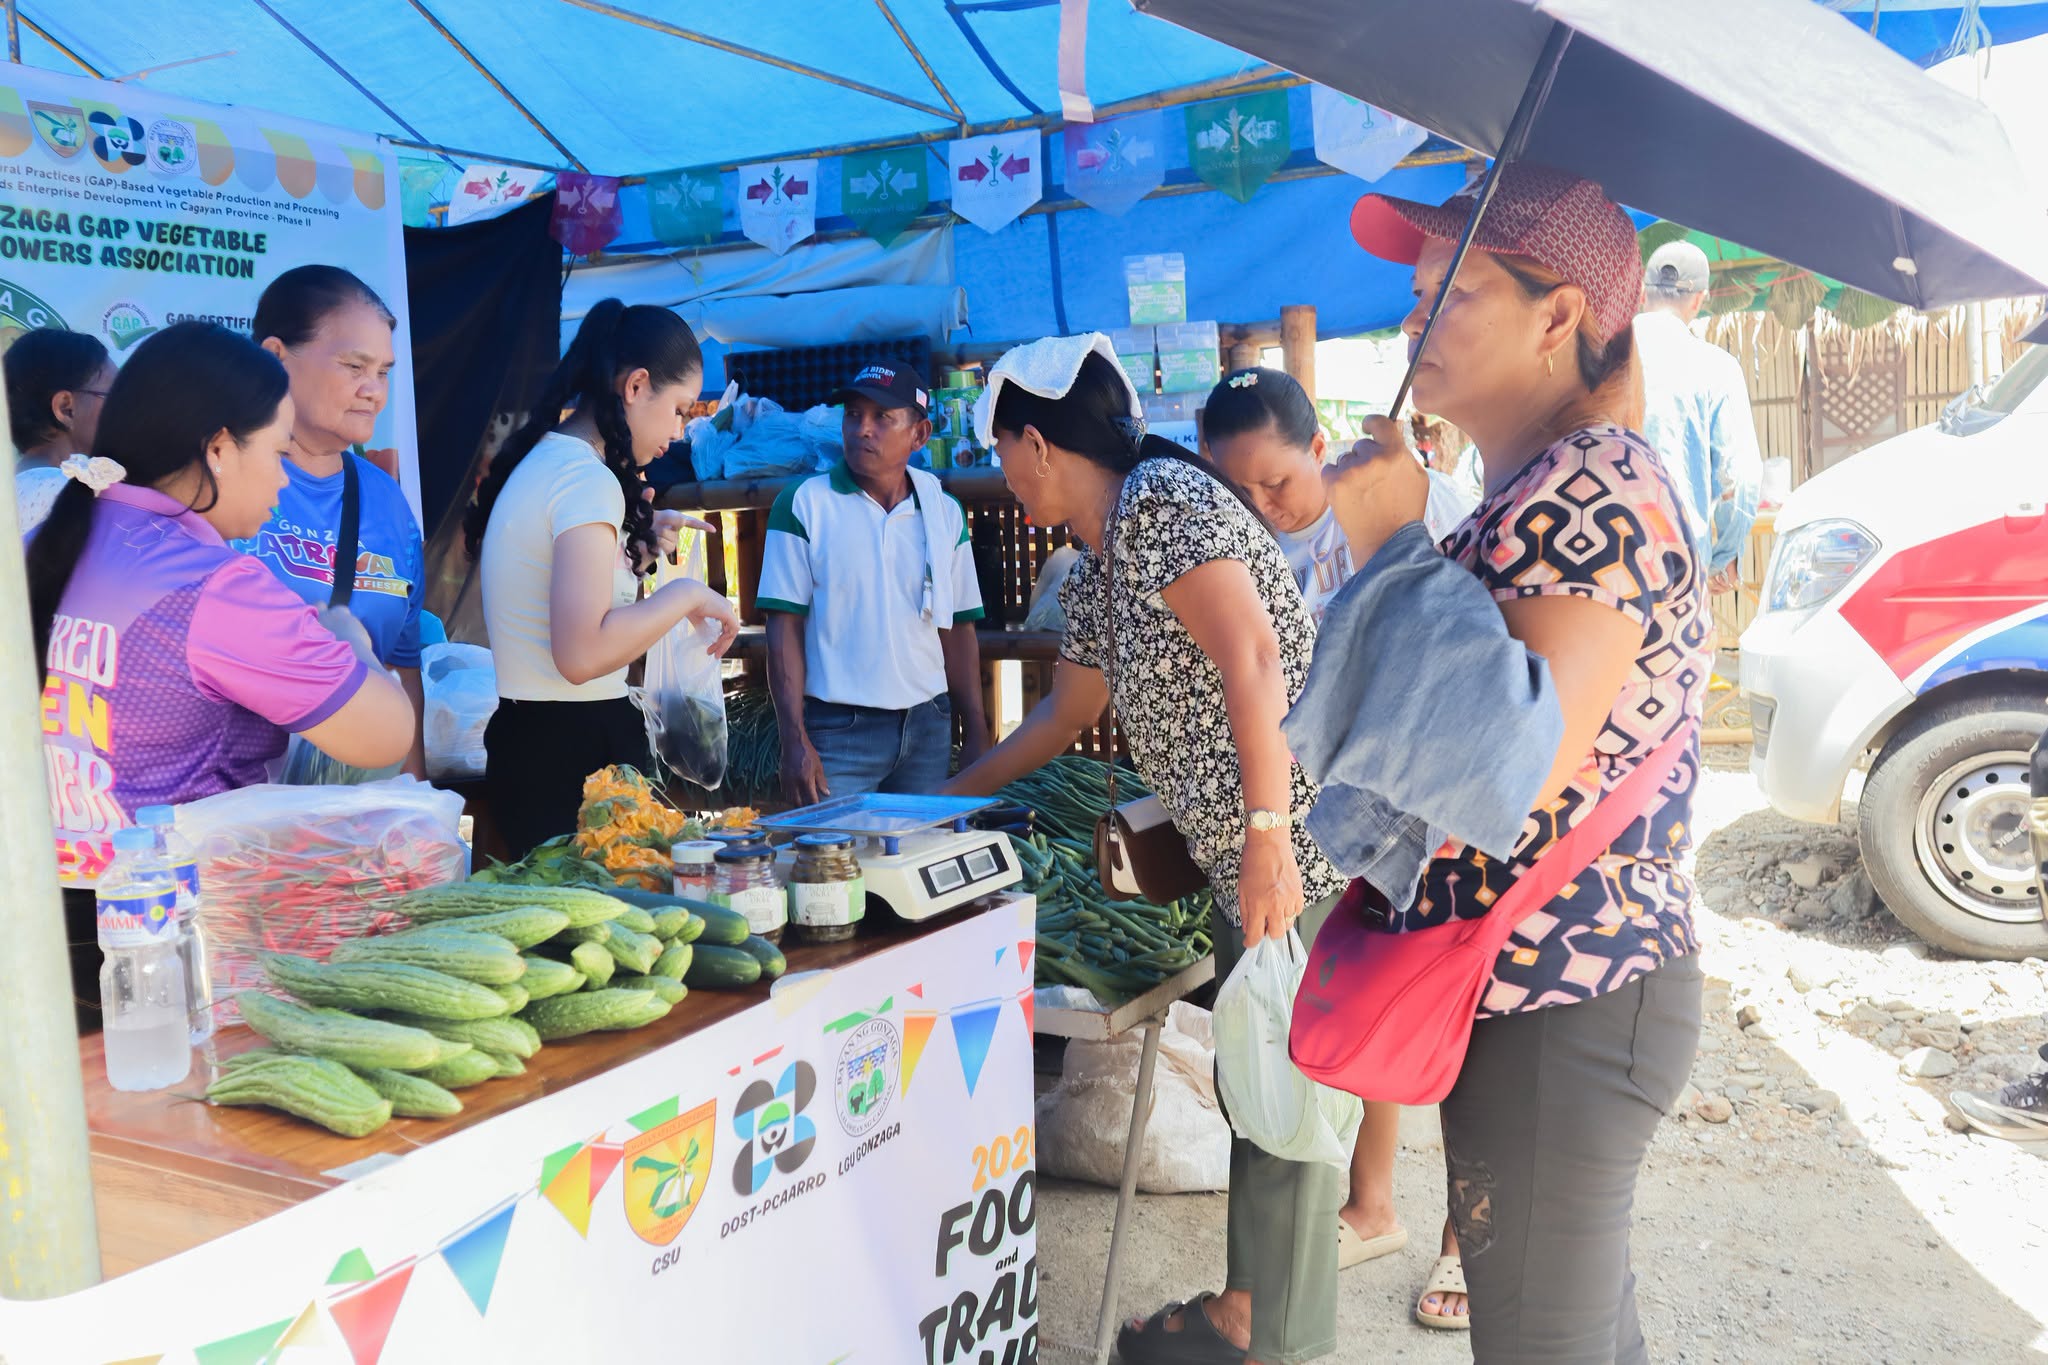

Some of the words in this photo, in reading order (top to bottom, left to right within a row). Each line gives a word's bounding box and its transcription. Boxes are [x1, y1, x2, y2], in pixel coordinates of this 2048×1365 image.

[17, 181, 80, 198] Enterprise
[84, 190, 162, 208] Development
[180, 201, 222, 216] Cagayan
[225, 207, 269, 221] Province
[277, 214, 303, 226] Phase
[25, 166, 81, 184] Practices
[84, 176, 154, 193] (GAP)-Based
[157, 184, 213, 200] Vegetable
[216, 191, 271, 208] Production
[273, 200, 290, 211] and
[292, 202, 340, 220] Processing
[0, 204, 71, 235] ZAGA
[78, 214, 130, 240] GAP
[135, 220, 267, 254] VEGETABLE
[0, 235, 93, 266] OWERS
[100, 245, 254, 279] ASSOCIATION
[112, 316, 141, 331] GAP
[869, 365, 896, 378] BIDEN
[363, 579, 406, 593] FIESTA
[838, 1151, 856, 1177] LGU
[856, 1121, 900, 1162] GONZAGA
[719, 1172, 827, 1240] DOST-PCAARRD
[651, 1246, 682, 1276] CSU
[995, 1246, 1018, 1271] and
